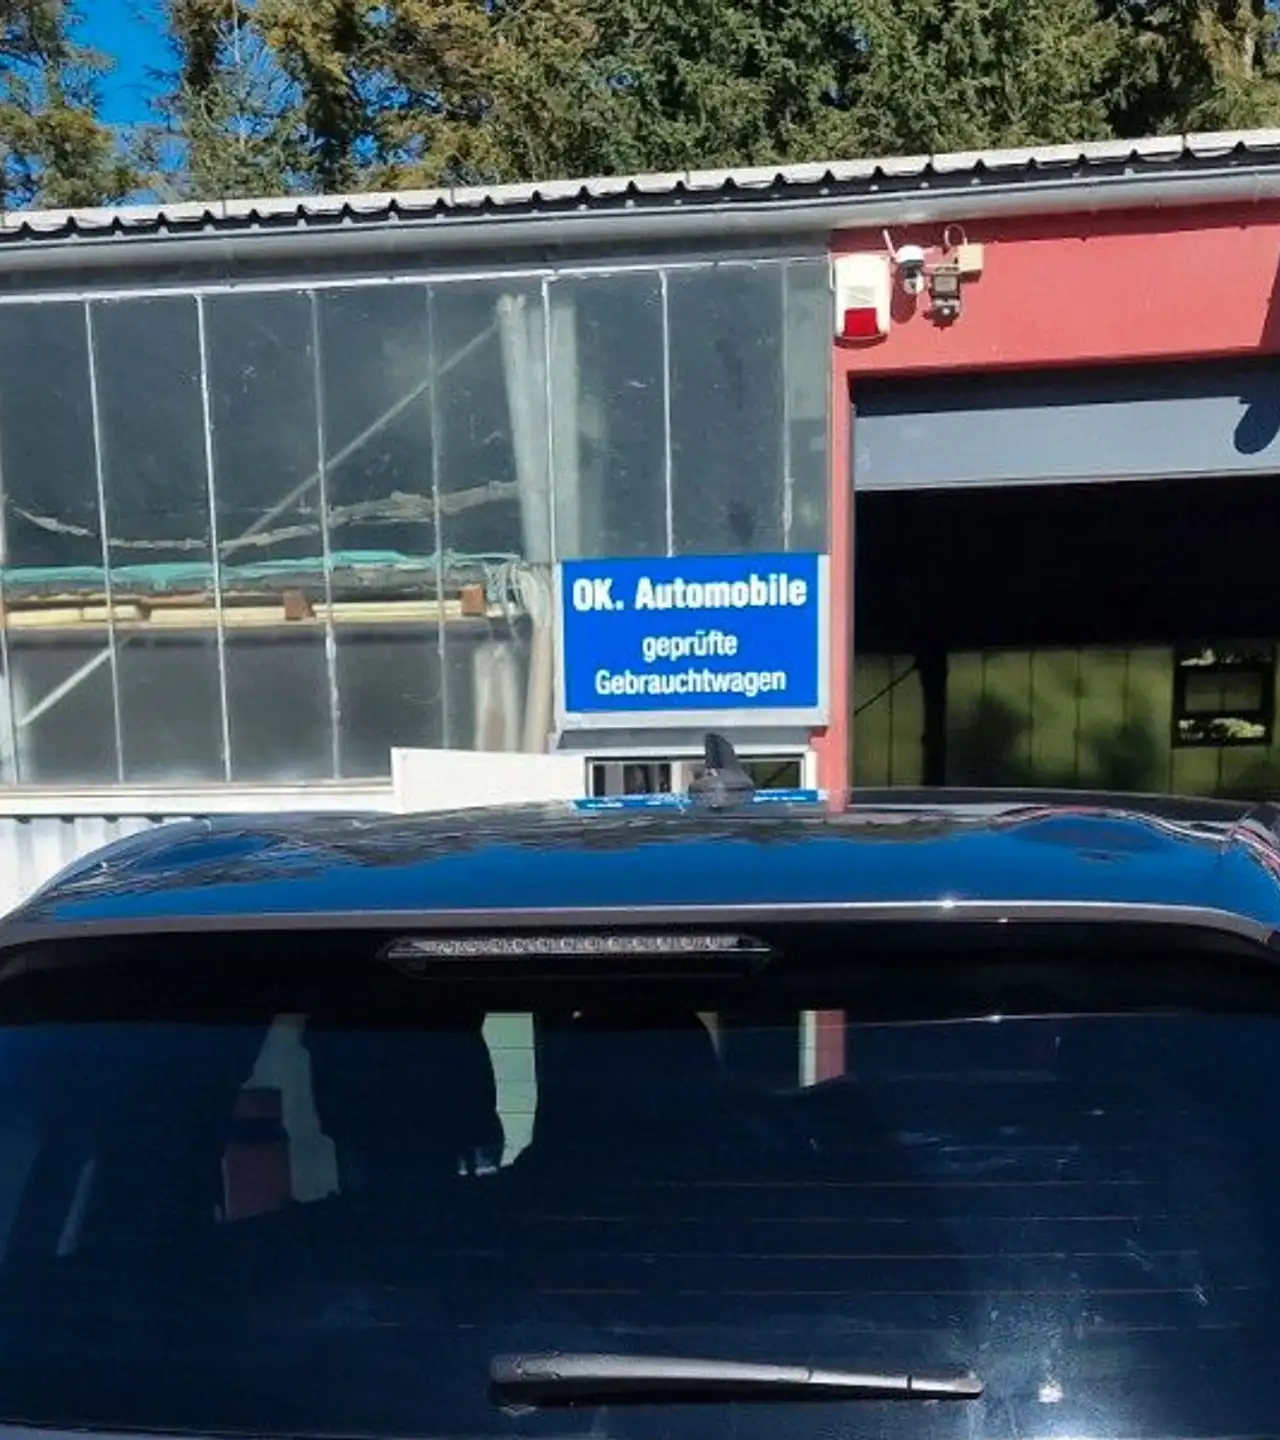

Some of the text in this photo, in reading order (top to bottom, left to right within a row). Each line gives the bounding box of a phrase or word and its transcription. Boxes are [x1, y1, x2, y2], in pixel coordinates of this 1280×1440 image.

[572, 573, 808, 611] OK. Automobile
[642, 629, 738, 663] geprüfte
[595, 667, 787, 698] Gebrauchtwagen
